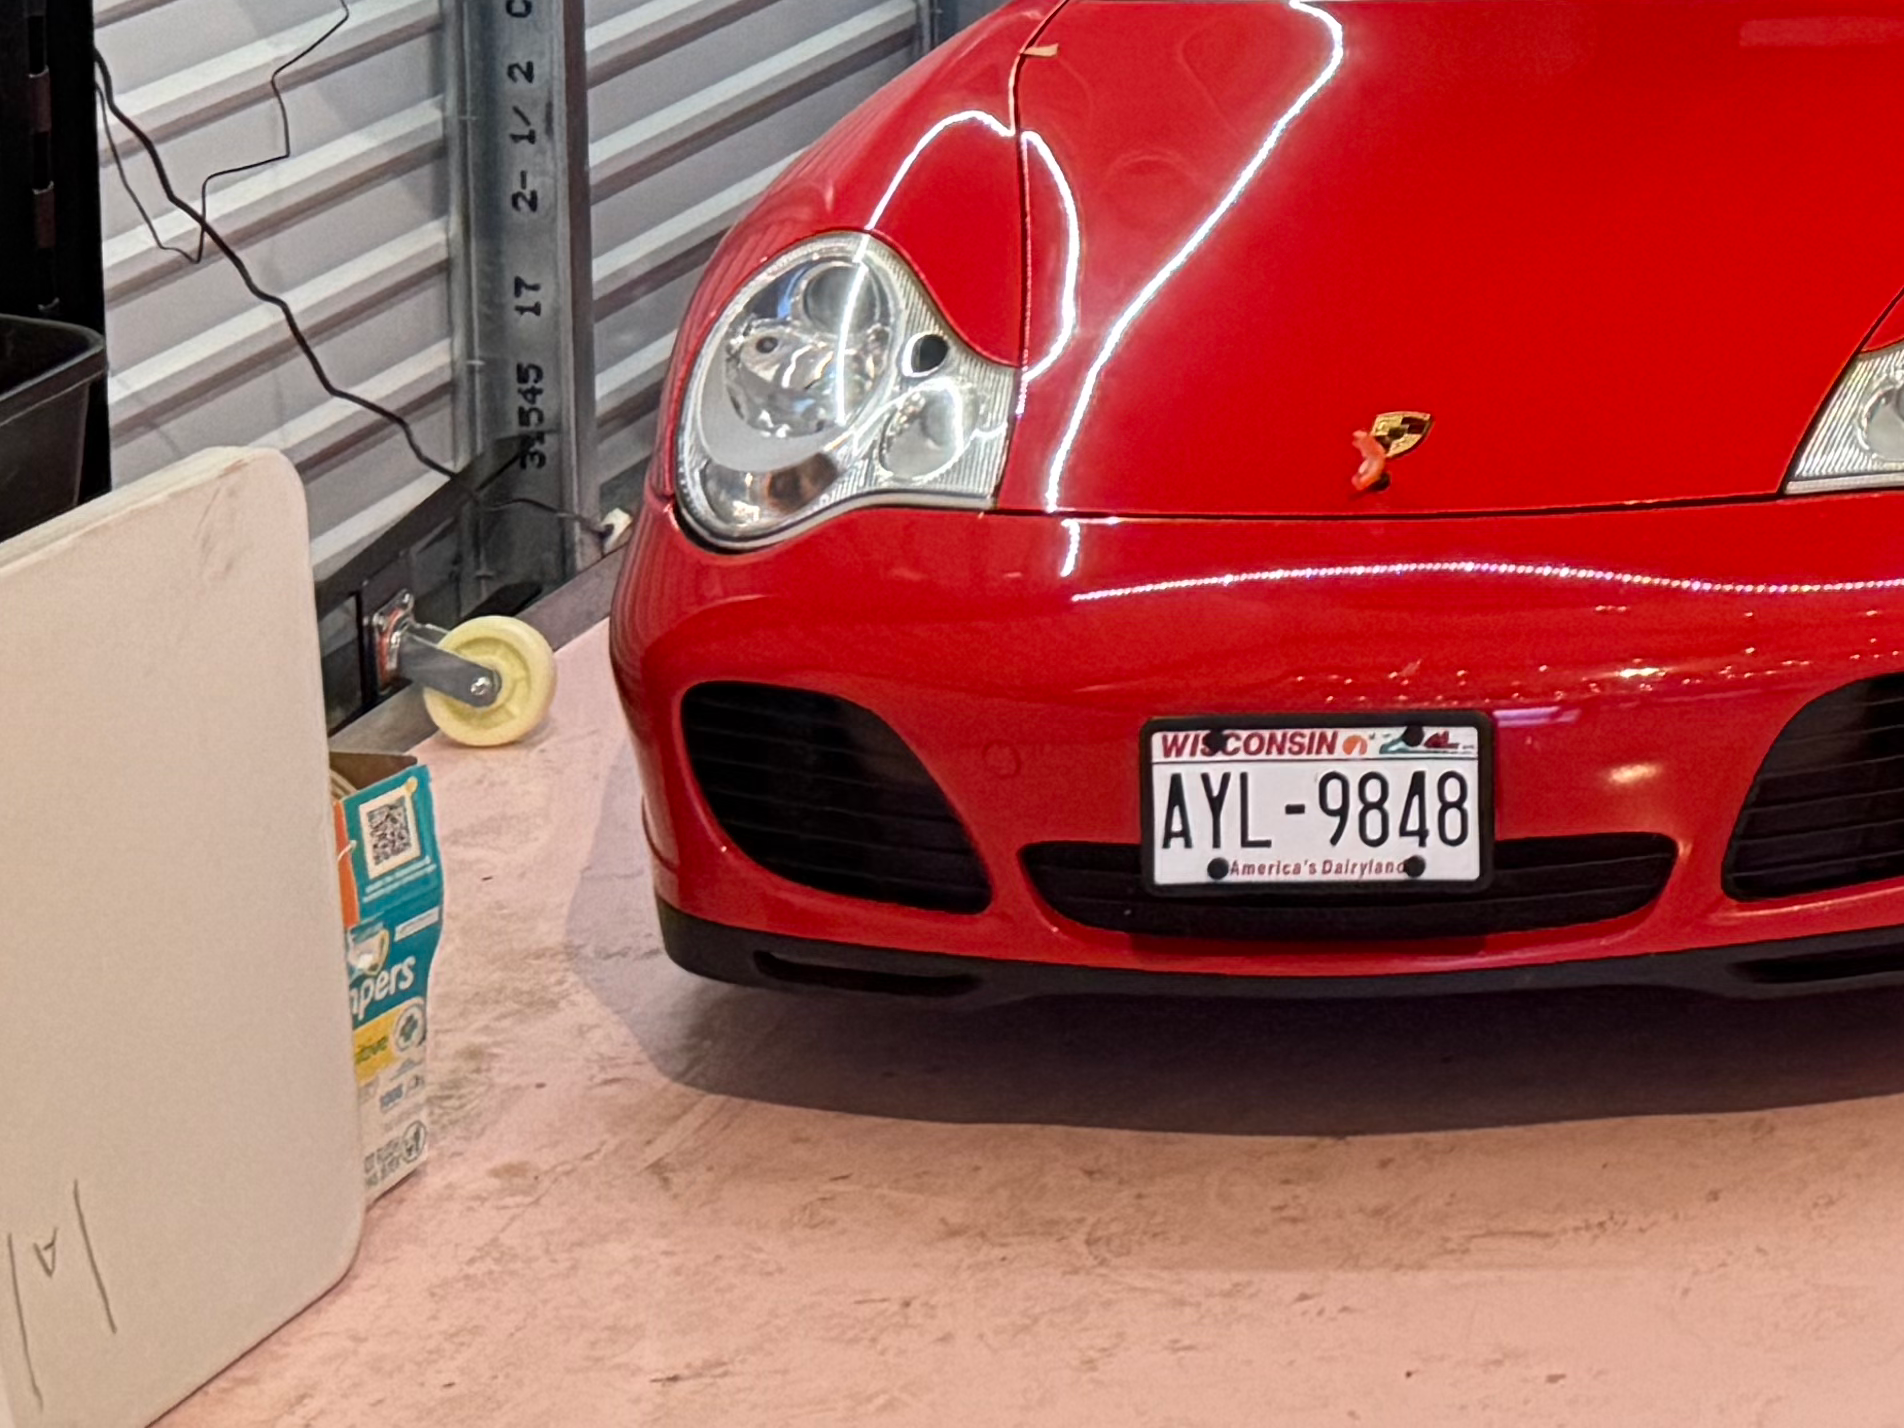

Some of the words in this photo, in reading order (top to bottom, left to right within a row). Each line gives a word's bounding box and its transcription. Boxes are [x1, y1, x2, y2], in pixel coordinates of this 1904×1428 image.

[514, 275, 542, 317] 17
[1162, 770, 1469, 849] AYL-9848
[1231, 859, 1317, 877] America's
